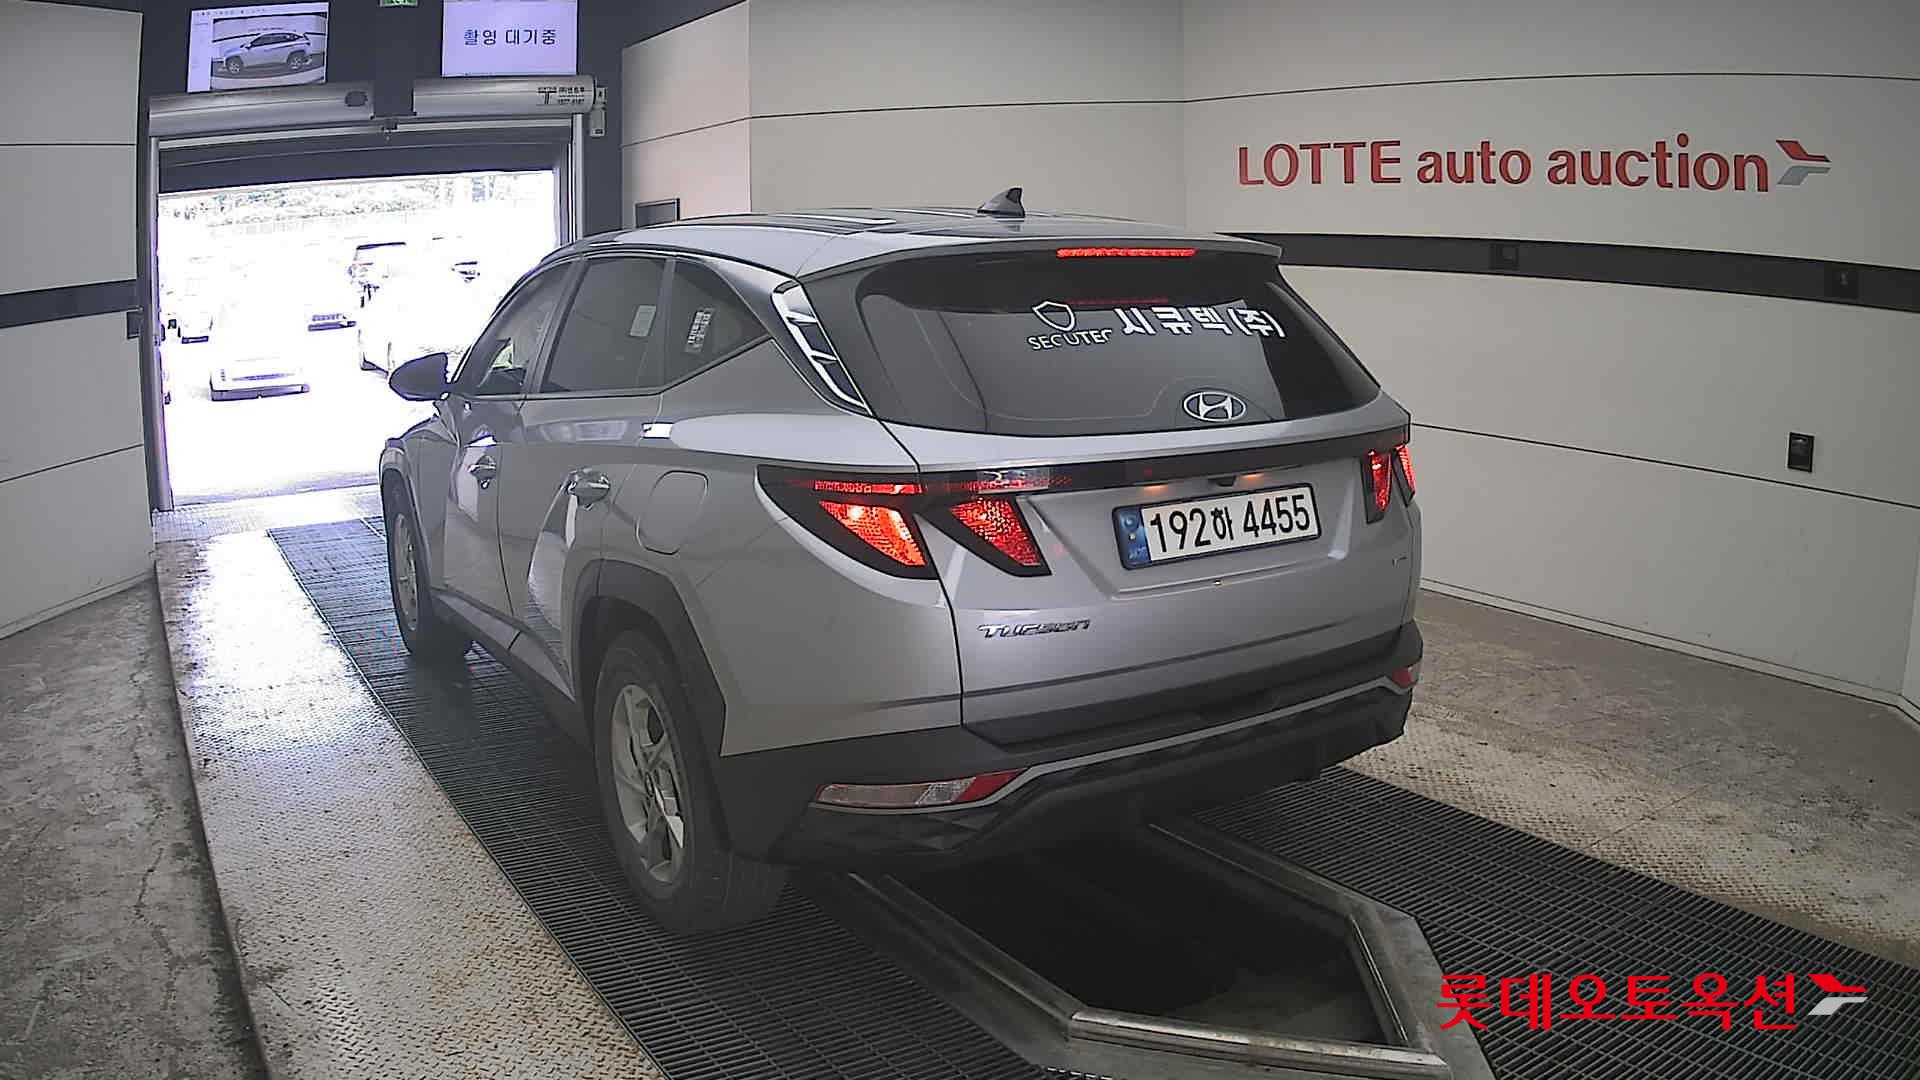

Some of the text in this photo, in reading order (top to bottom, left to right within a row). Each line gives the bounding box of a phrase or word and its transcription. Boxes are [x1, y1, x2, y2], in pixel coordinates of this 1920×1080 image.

[464, 29, 556, 45] 촬영 대기중
[1238, 132, 1769, 192] LOTTE auto auction
[1150, 494, 1311, 552] 192하 4455
